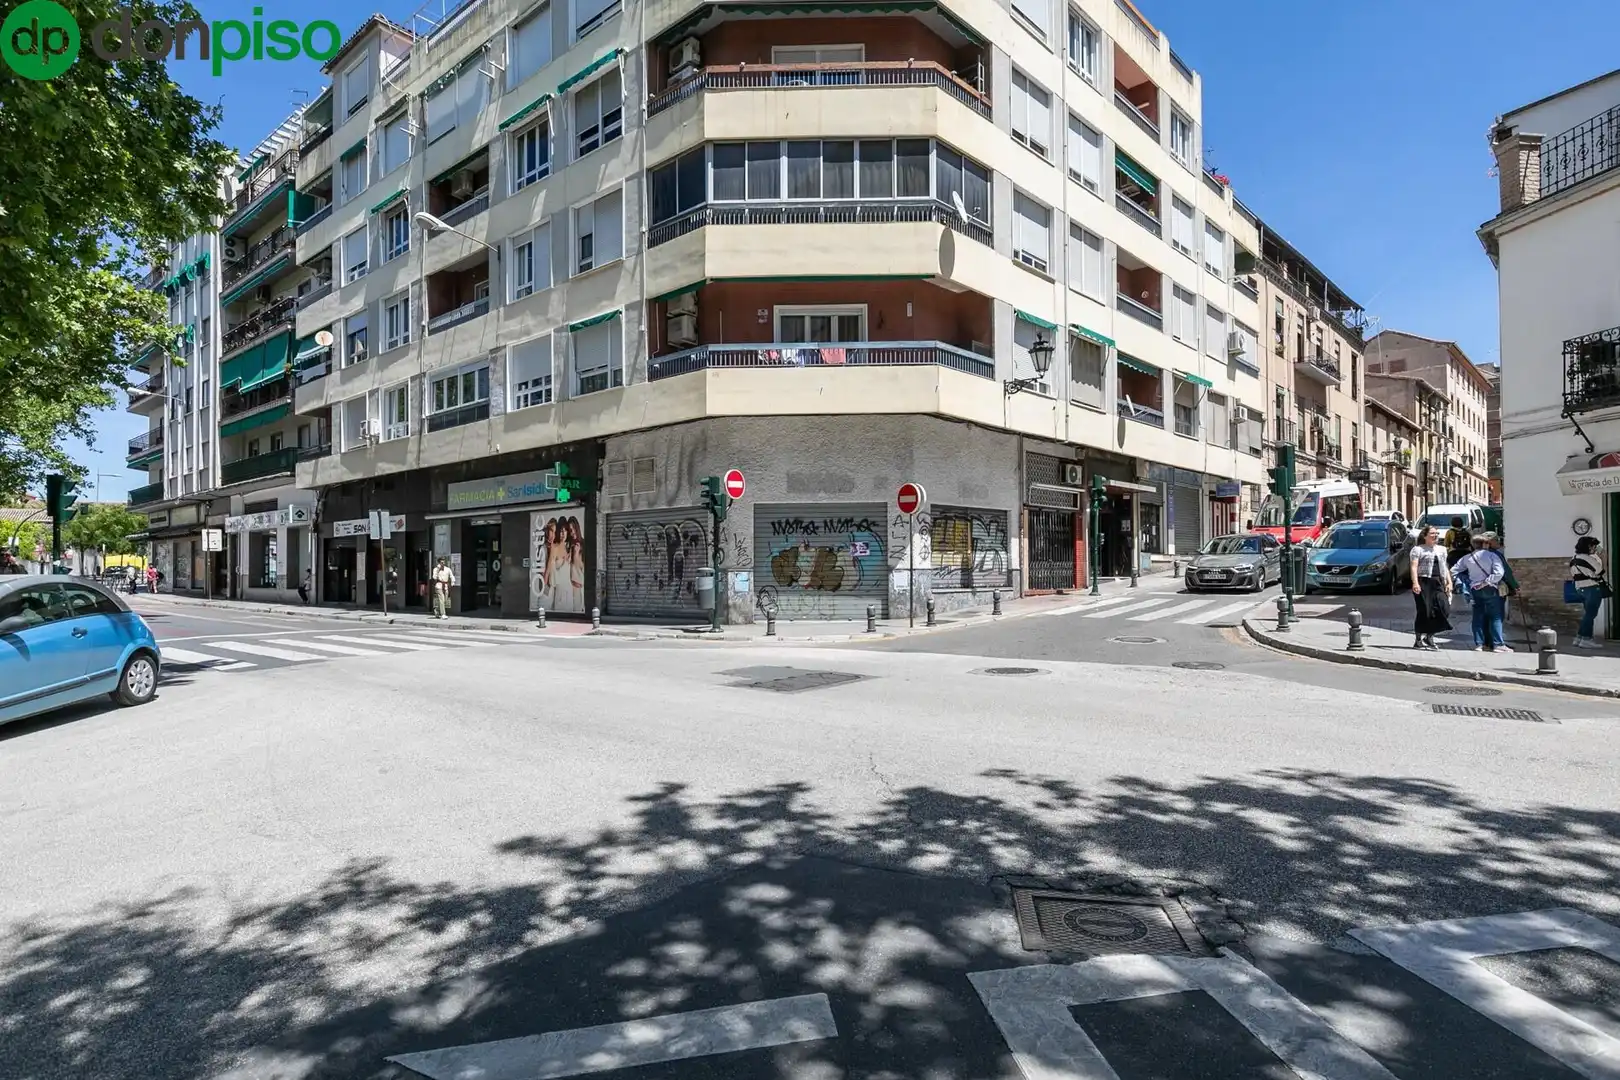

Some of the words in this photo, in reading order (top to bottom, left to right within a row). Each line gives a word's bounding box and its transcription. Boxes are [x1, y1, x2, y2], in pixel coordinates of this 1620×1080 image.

[1602, 477, 1613, 486] de
[449, 489, 495, 505] FARMACIA
[531, 514, 546, 597] Olistic
